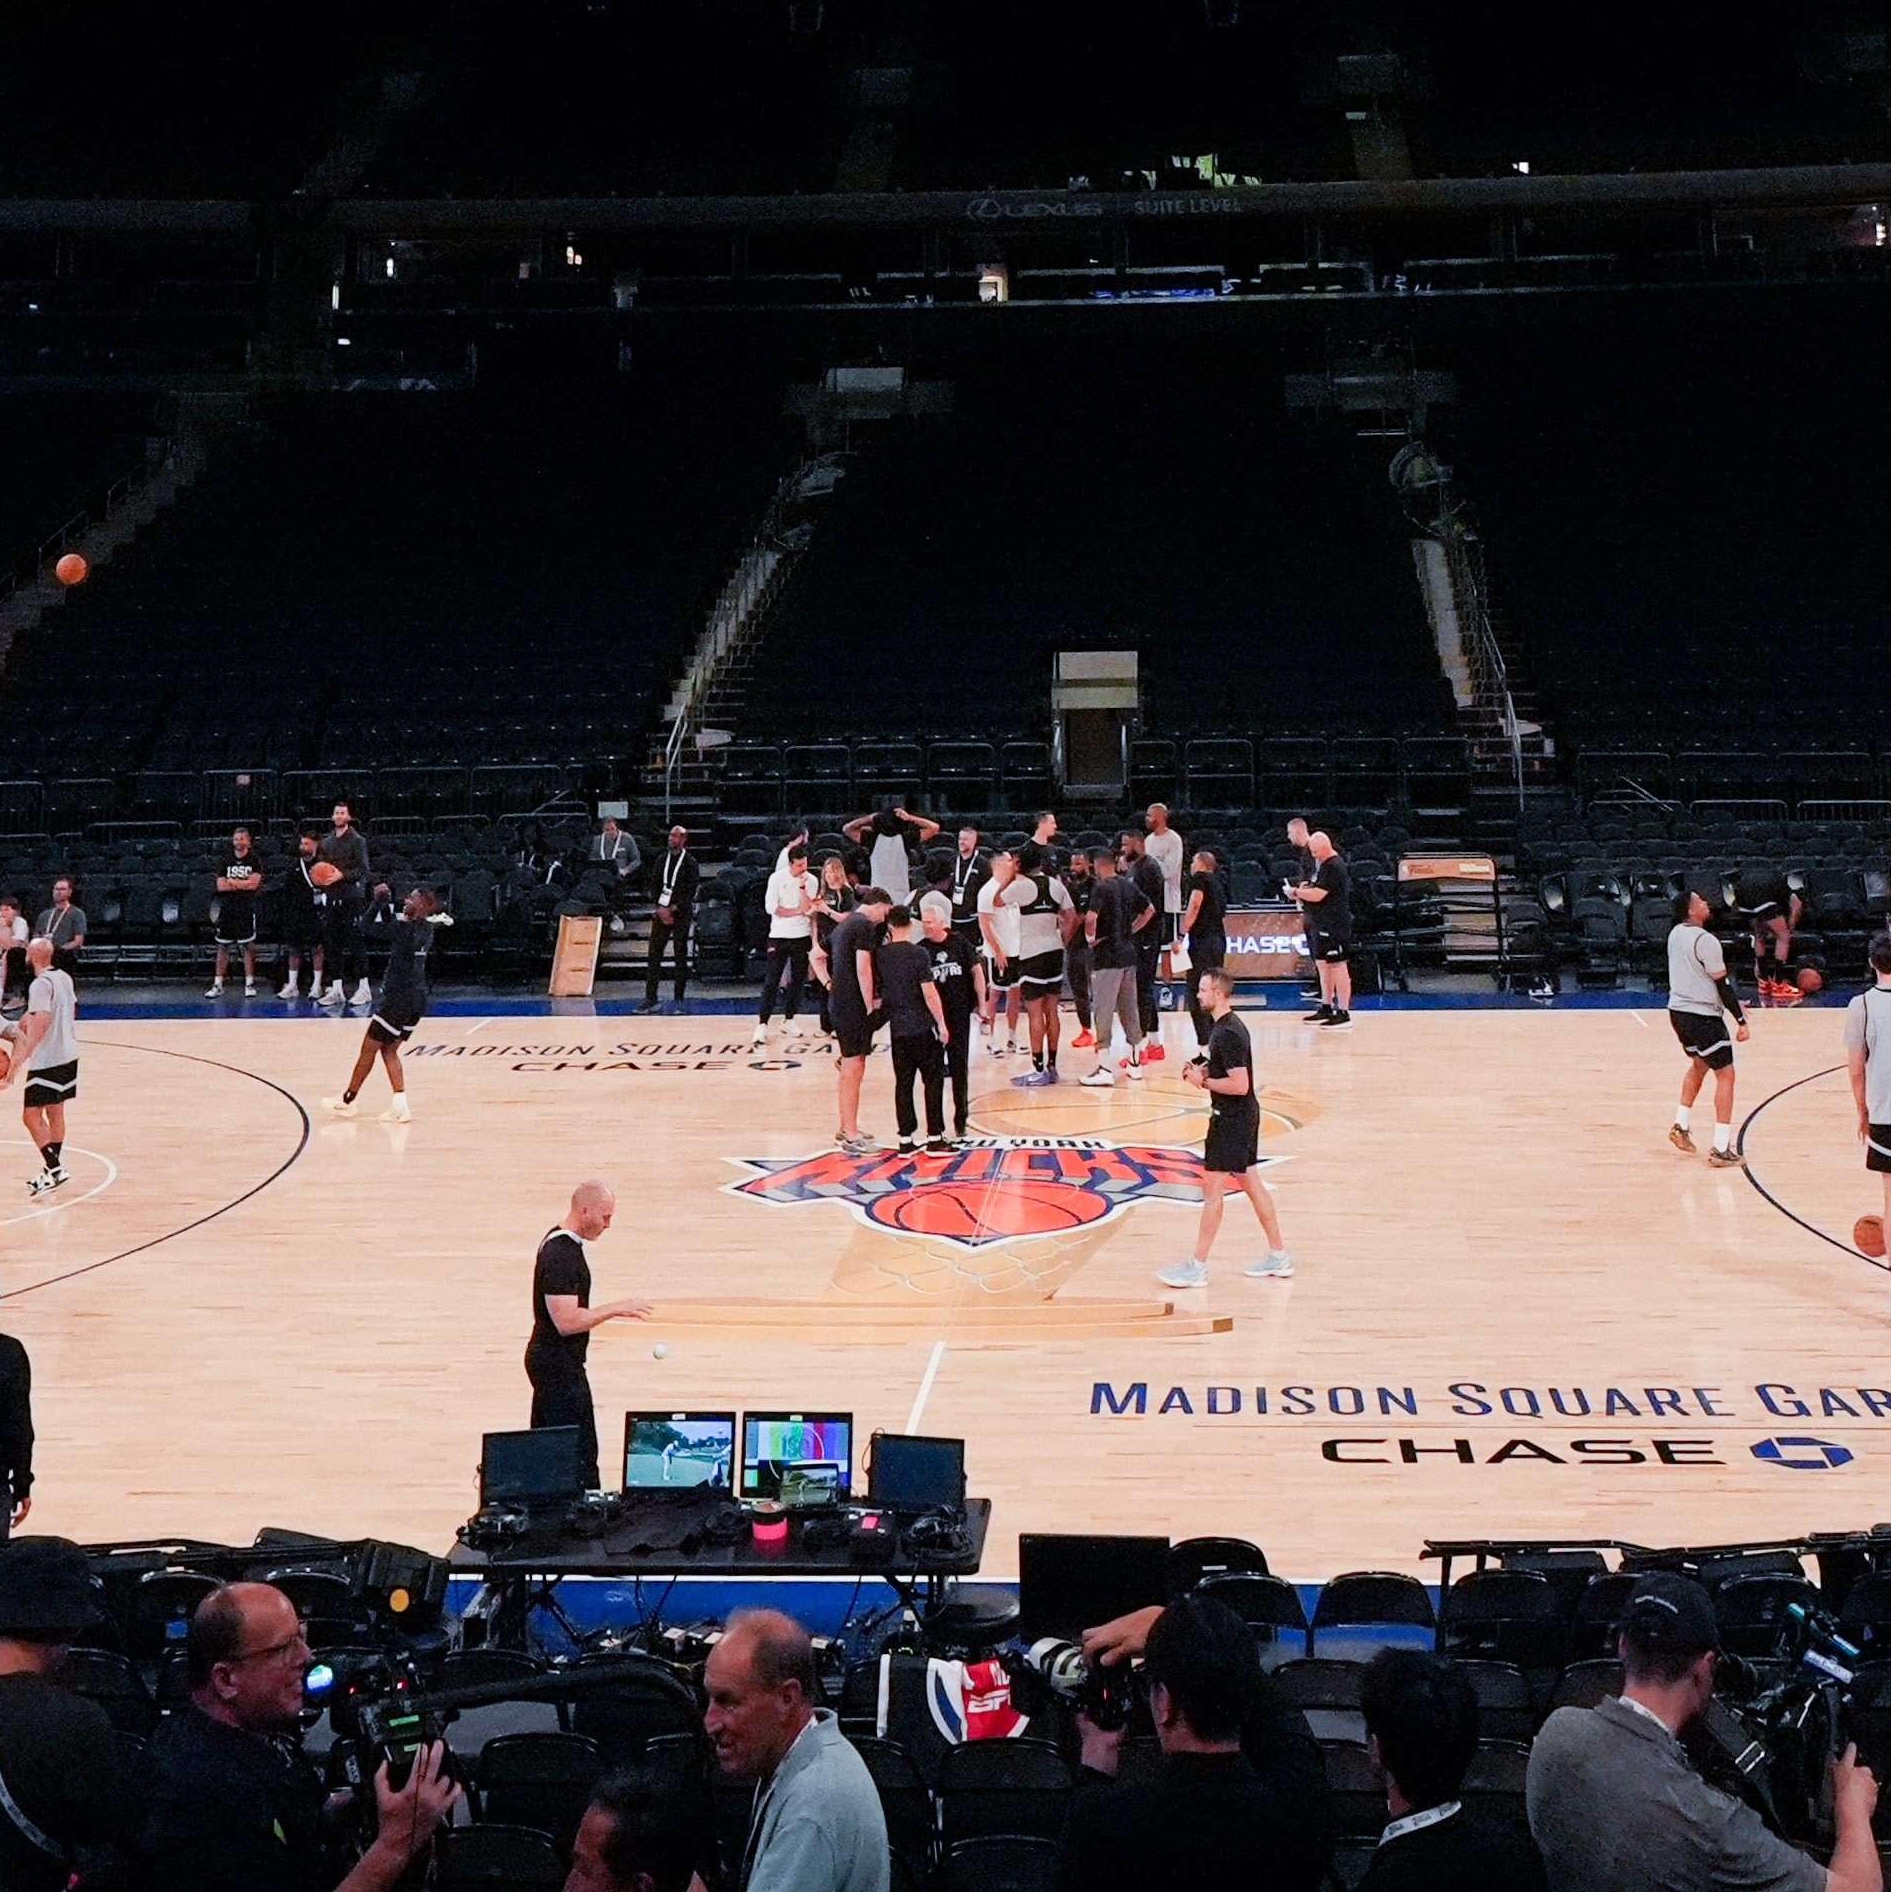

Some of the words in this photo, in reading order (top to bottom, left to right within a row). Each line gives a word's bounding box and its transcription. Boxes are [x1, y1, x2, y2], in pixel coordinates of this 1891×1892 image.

[1134, 197, 1186, 215] SUITE
[1190, 196, 1242, 214] LEVEL
[1225, 934, 1297, 955] HASE
[404, 1043, 595, 1058] MADISON
[510, 1061, 729, 1072] CHASE
[1009, 1137, 1107, 1151] YORK
[1088, 1380, 1419, 1418] MADISON
[1446, 1382, 1738, 1420] SQUARE
[1319, 1437, 1728, 1467] CHASE
[967, 1688, 1011, 1714] ESP
